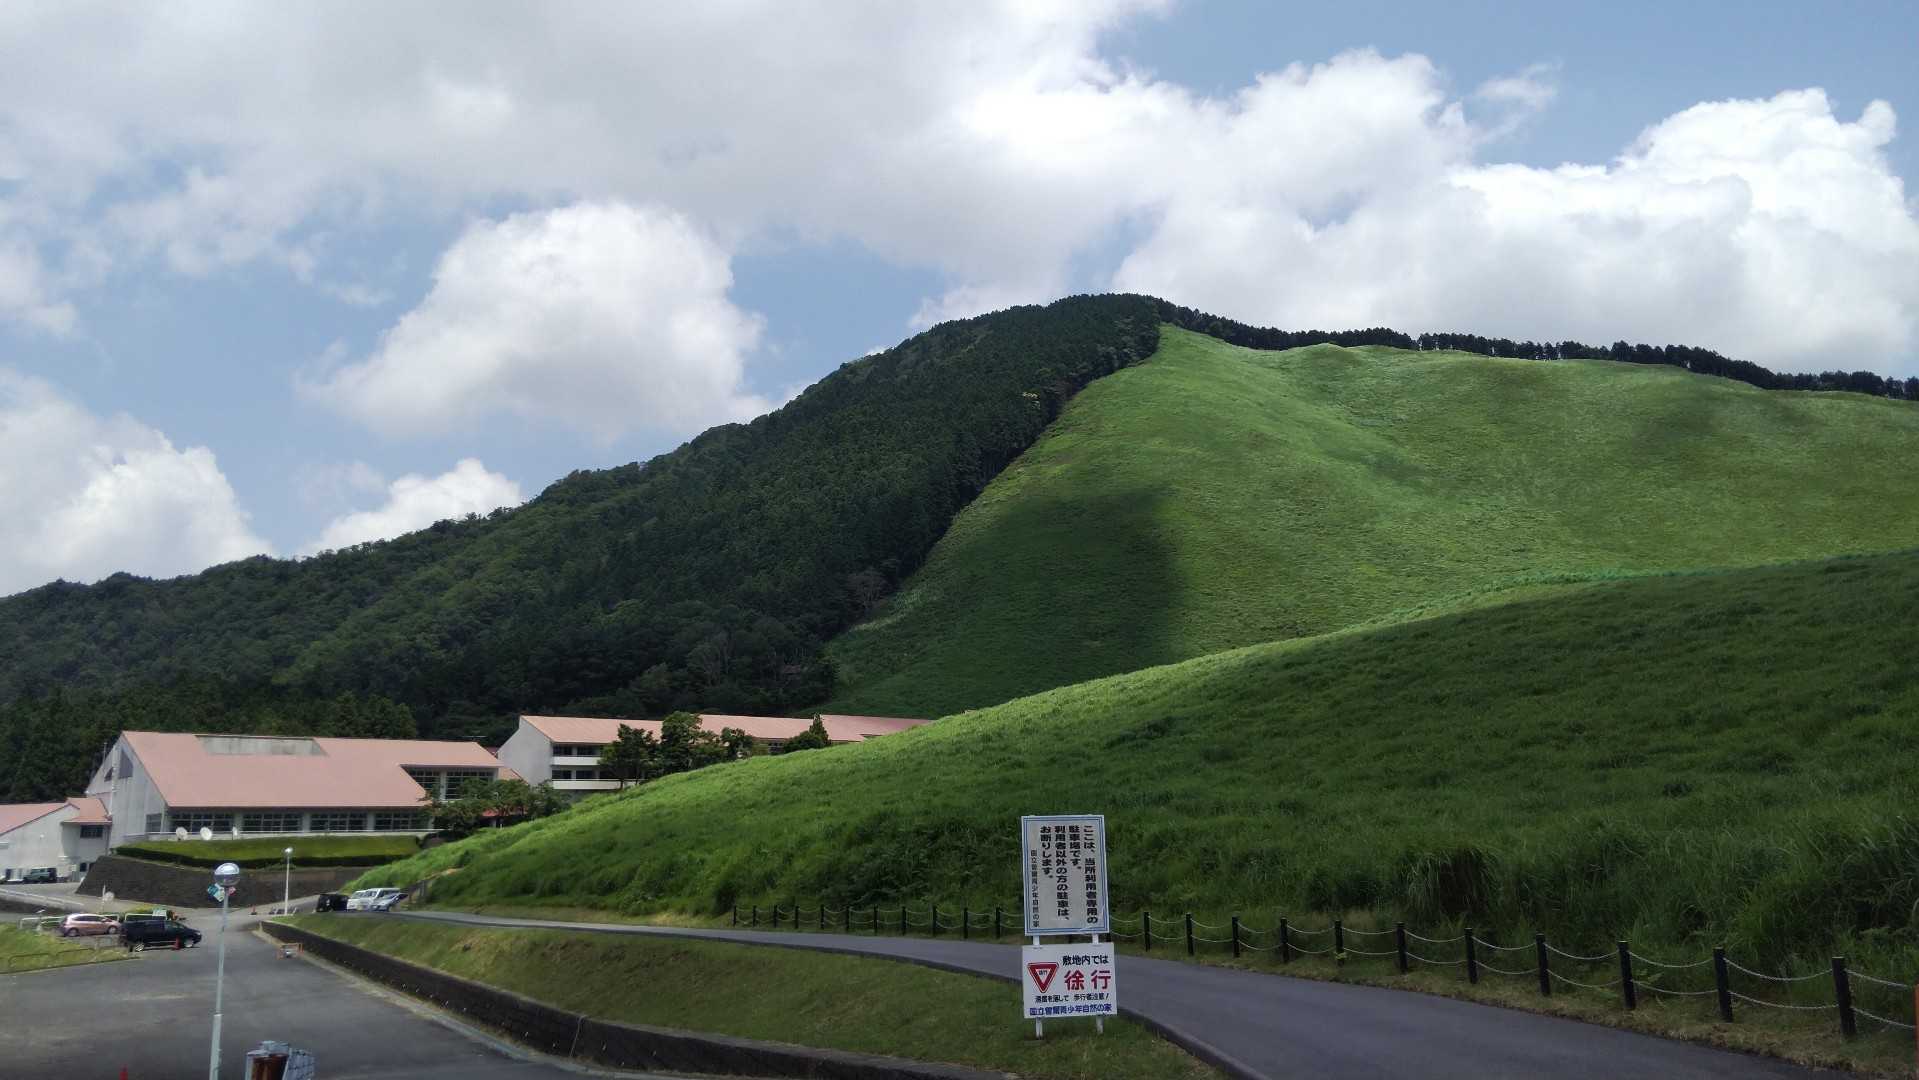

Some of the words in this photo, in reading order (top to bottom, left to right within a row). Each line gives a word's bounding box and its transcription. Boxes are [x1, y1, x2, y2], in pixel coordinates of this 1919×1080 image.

[1040, 826, 1053, 878] お断りします。
[1069, 825, 1082, 870] 駐車場です。
[1055, 825, 1069, 920] 利用者以外の方の駐車は、
[1062, 954, 1109, 966] 敷地内では
[1064, 969, 1112, 991] 徐行
